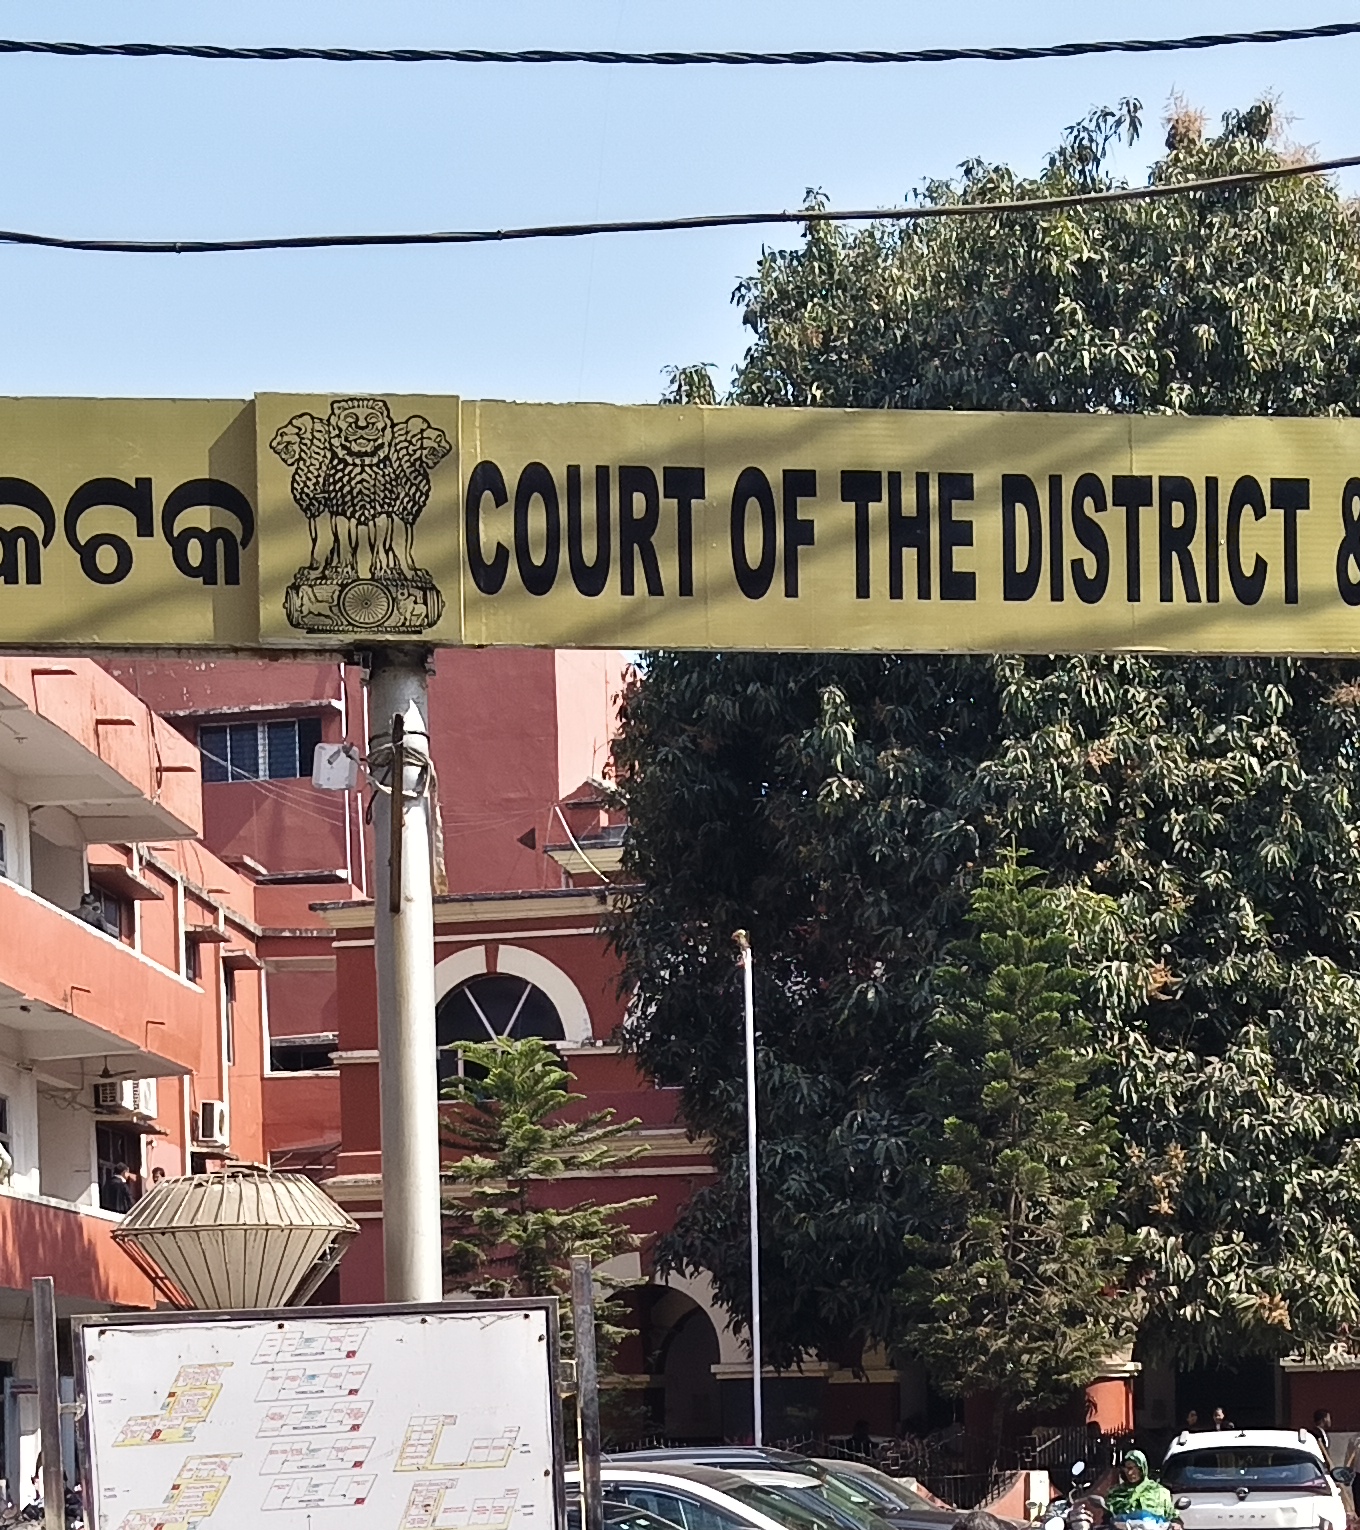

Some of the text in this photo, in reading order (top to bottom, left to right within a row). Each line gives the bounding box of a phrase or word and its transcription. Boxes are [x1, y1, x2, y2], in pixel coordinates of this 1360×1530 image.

[465, 459, 707, 598] COURT
[730, 465, 817, 600] OF
[840, 469, 978, 602] THE
[1001, 471, 1311, 606] DISTRICT
